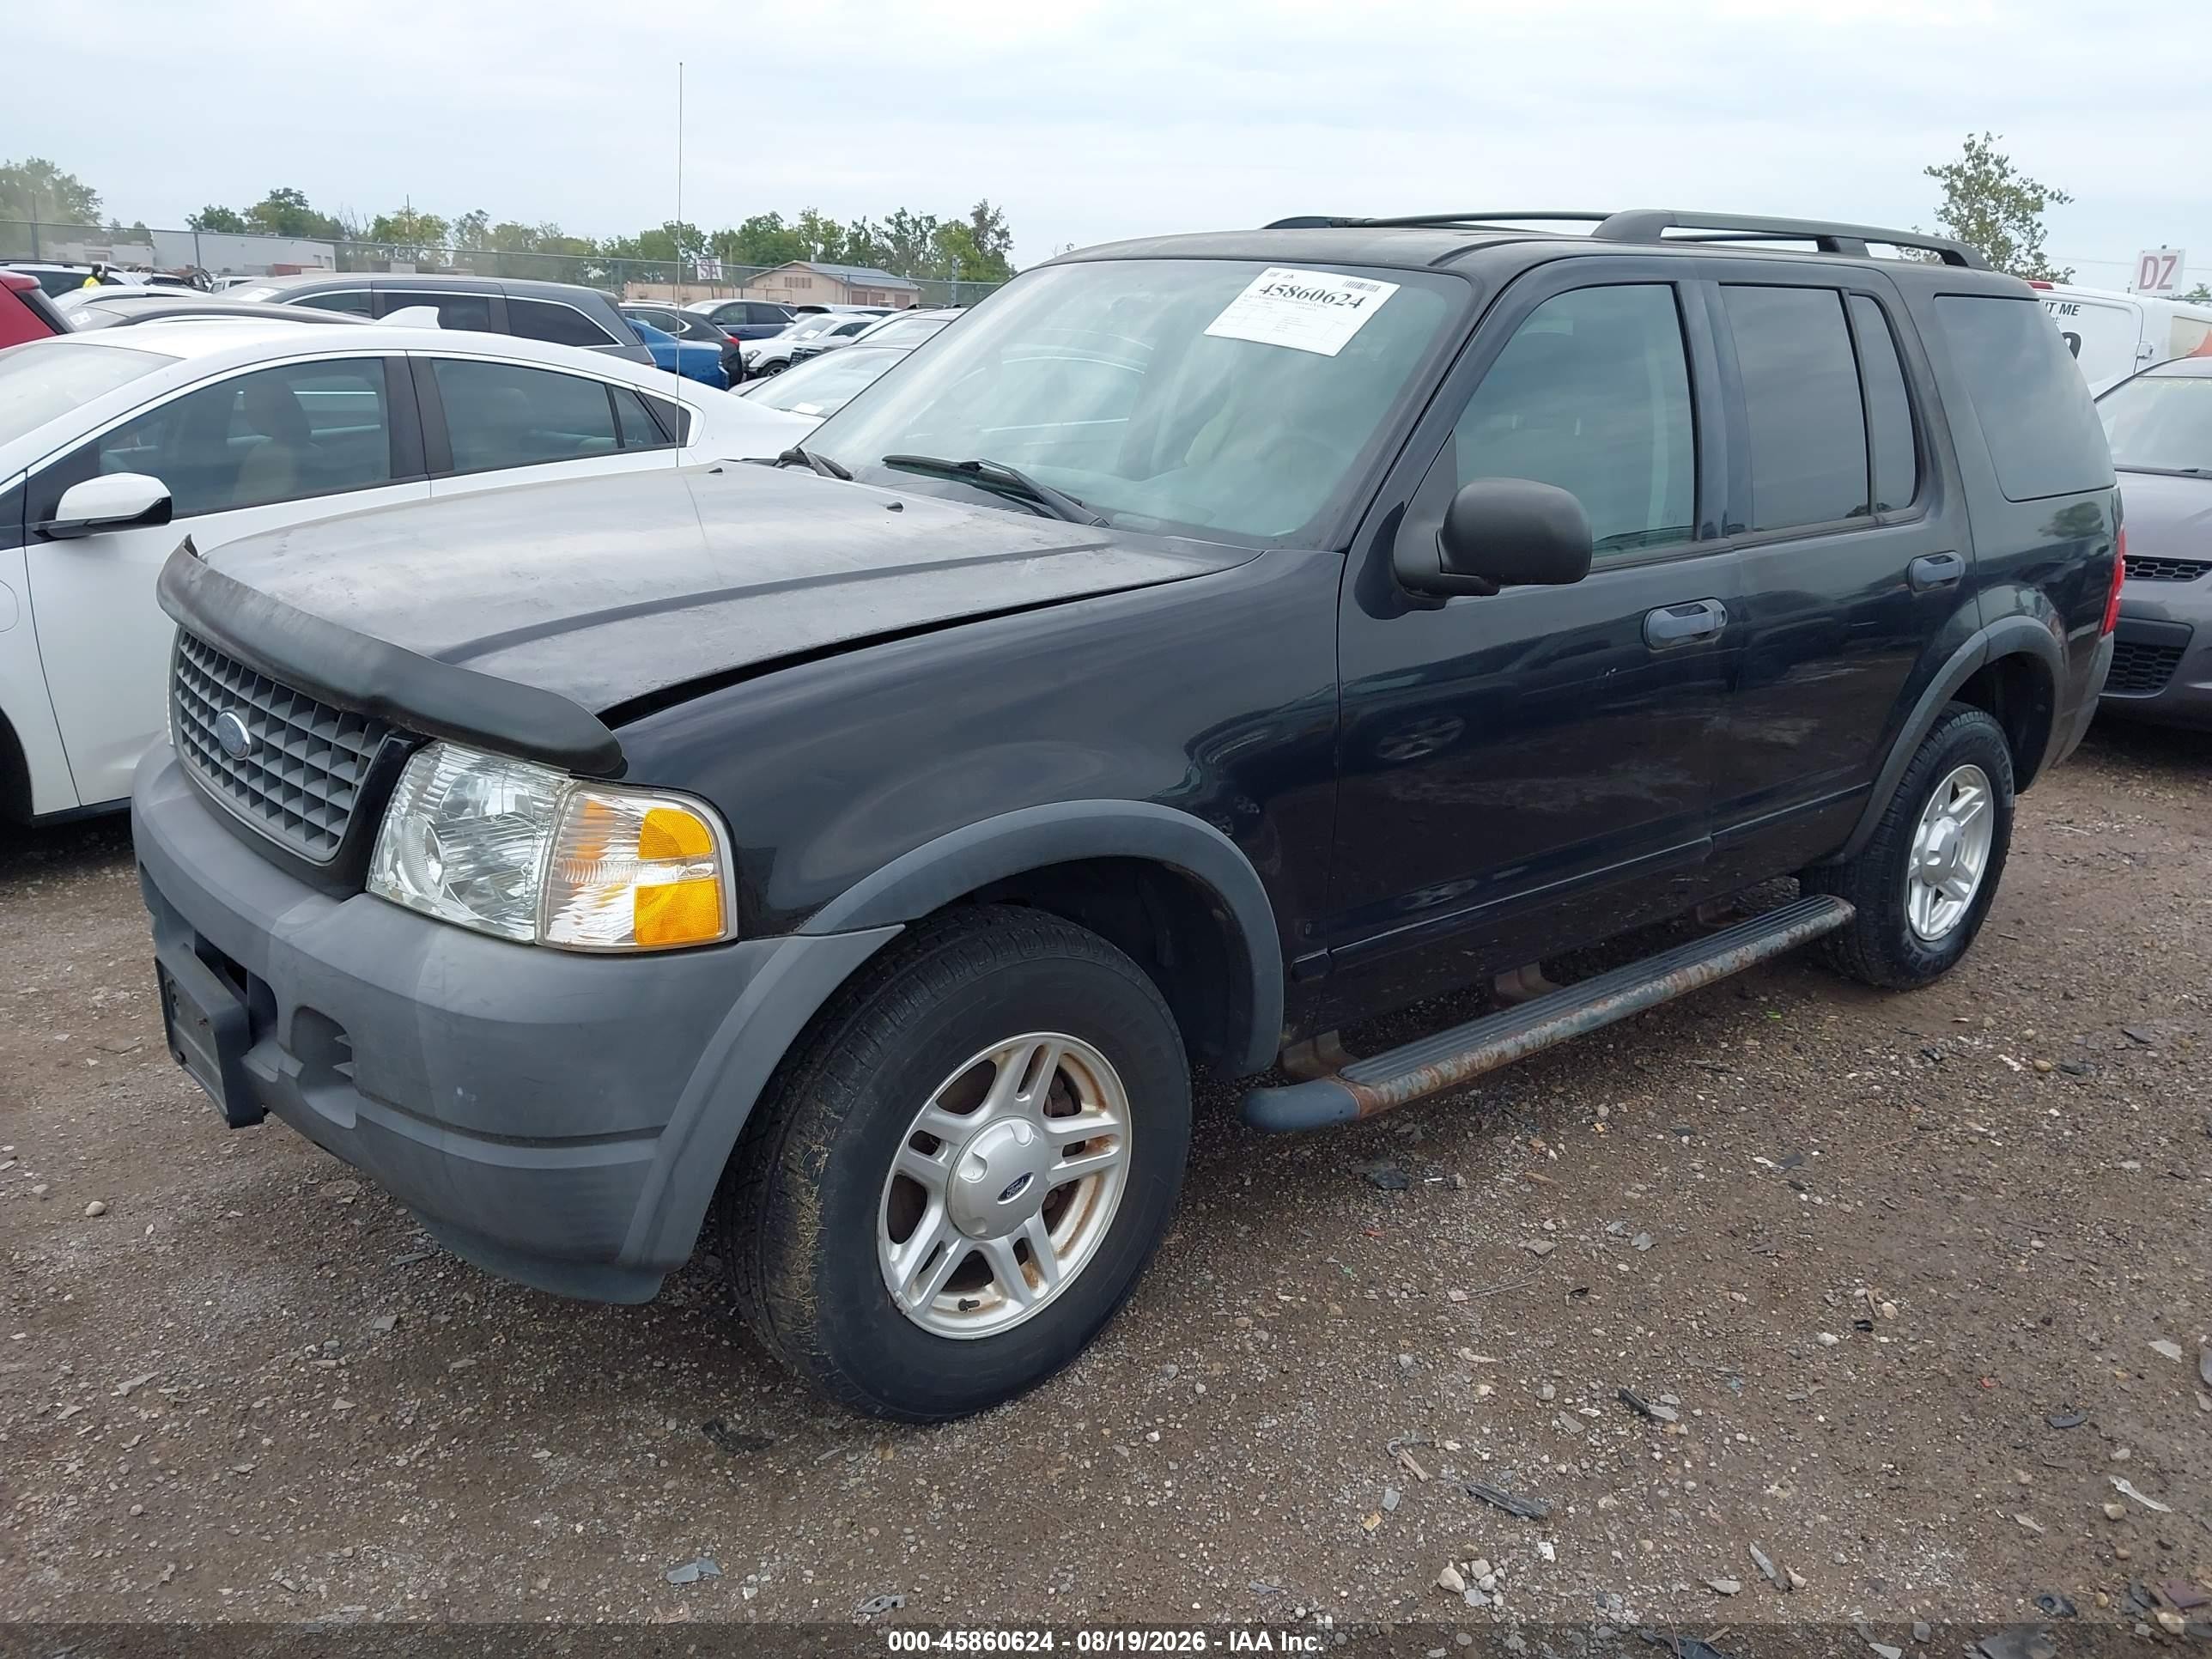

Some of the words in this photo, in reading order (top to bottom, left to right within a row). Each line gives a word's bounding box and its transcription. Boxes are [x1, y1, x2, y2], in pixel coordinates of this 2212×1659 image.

[700, 259, 720, 279] SA
[2138, 255, 2179, 290] DZ
[1258, 283, 1367, 309] 45860624
[2059, 302, 2081, 316] ME
